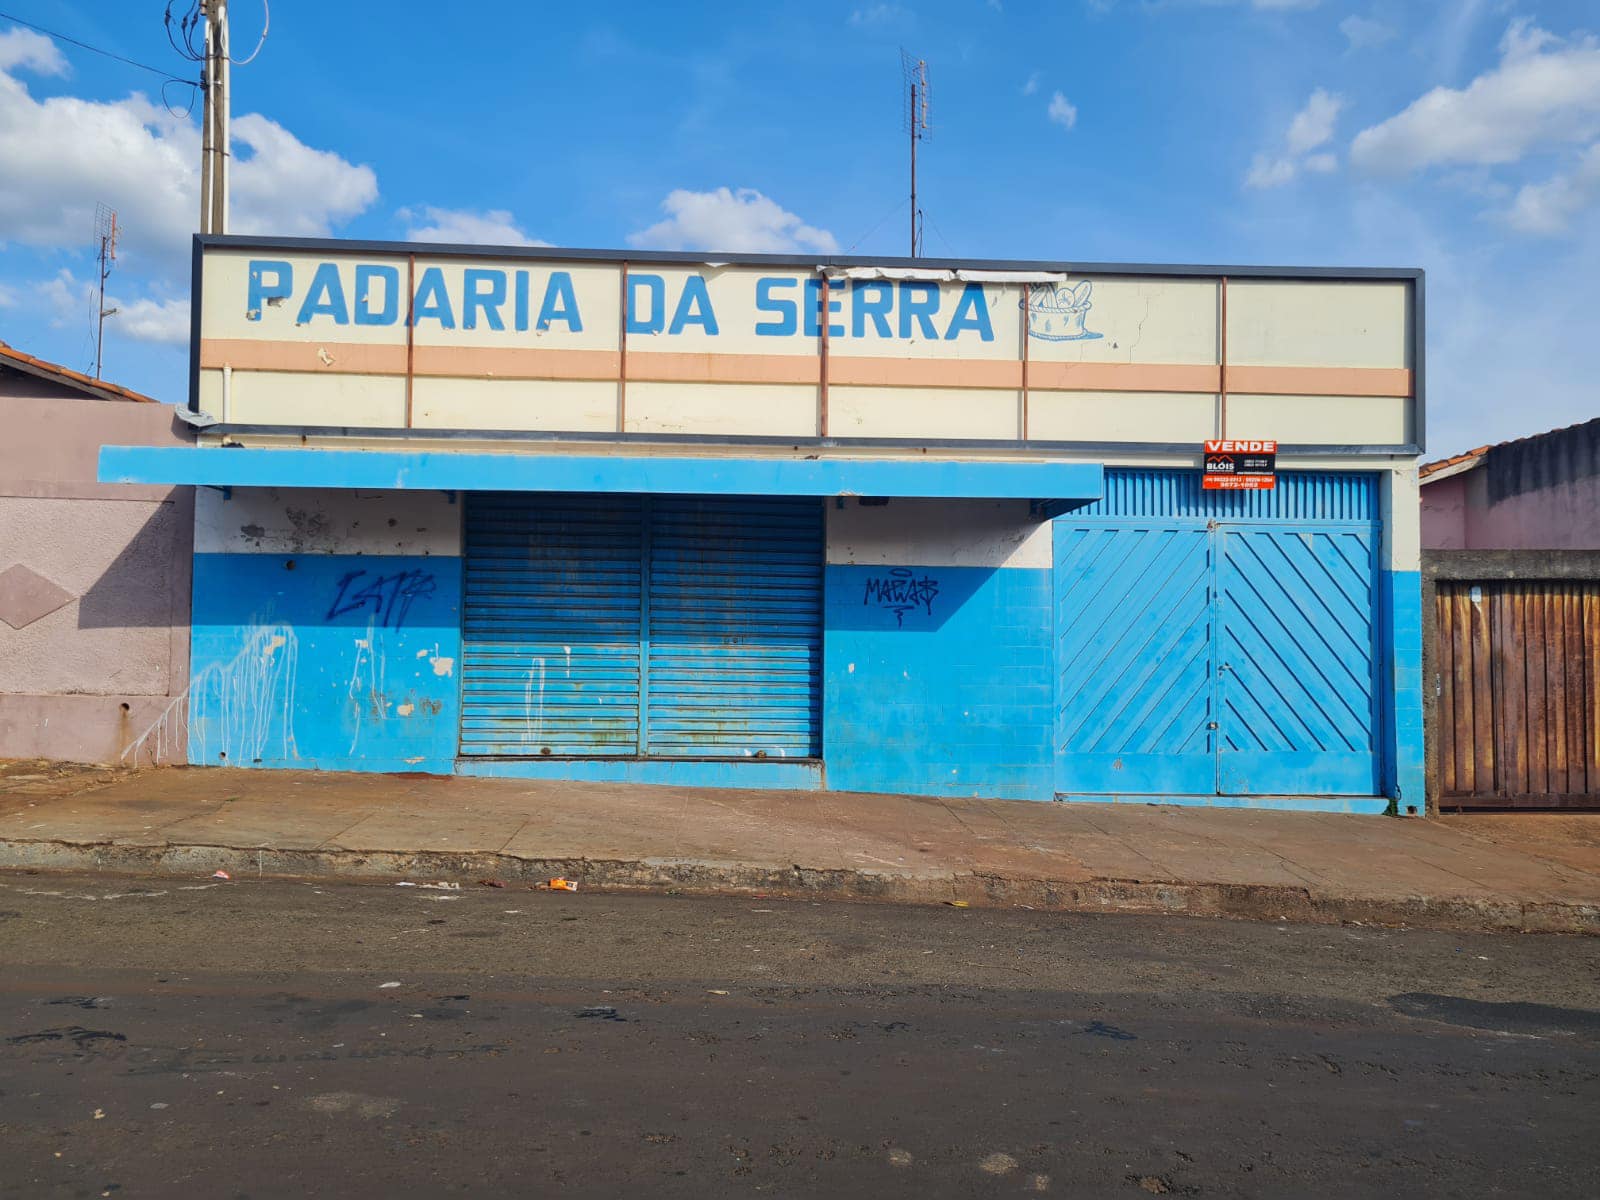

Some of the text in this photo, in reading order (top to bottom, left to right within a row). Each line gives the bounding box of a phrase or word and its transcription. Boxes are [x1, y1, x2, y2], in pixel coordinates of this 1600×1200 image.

[247, 260, 995, 341] PADARIA DA SERRA
[1207, 441, 1275, 453] VENDE
